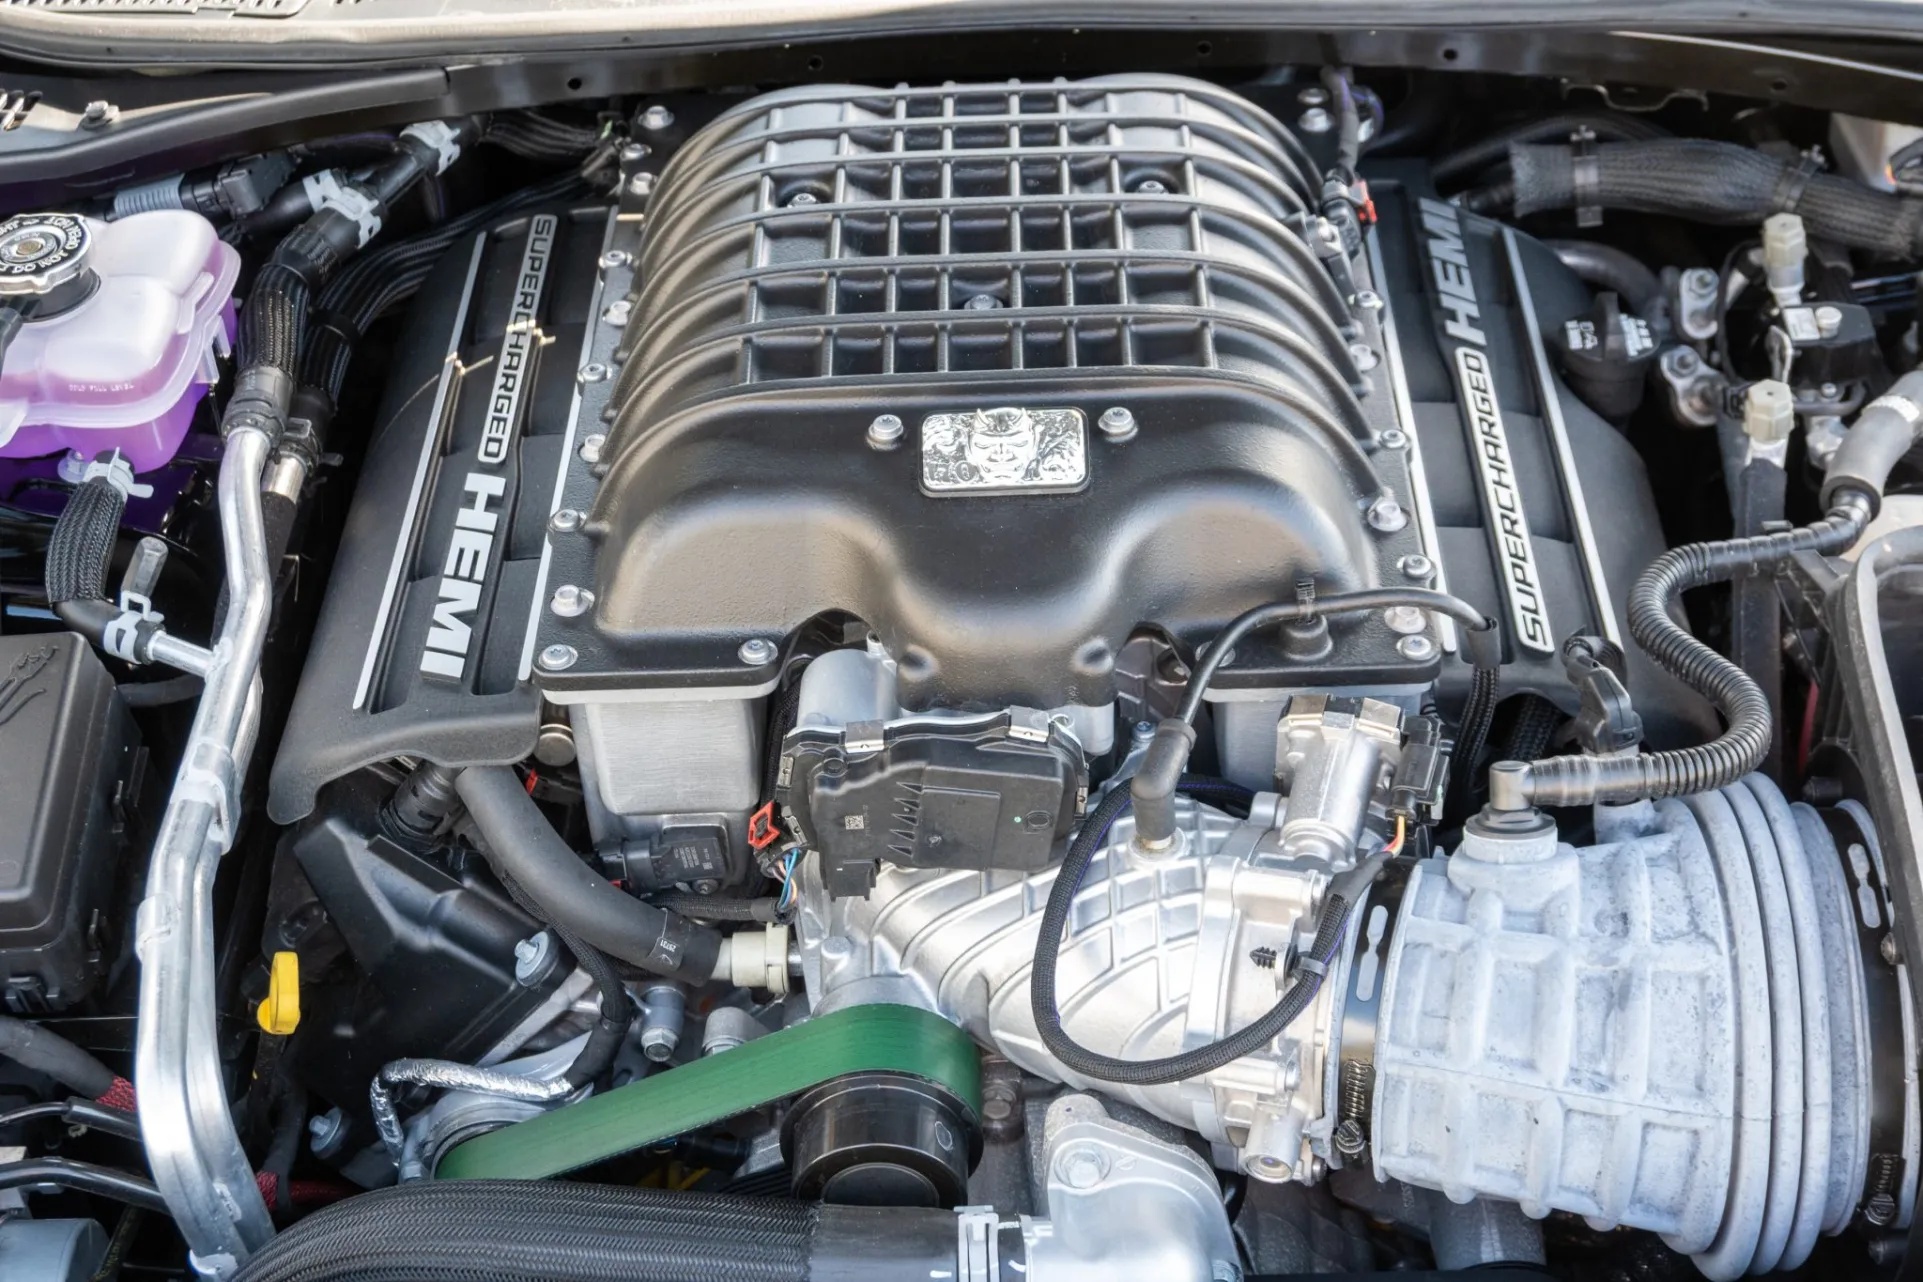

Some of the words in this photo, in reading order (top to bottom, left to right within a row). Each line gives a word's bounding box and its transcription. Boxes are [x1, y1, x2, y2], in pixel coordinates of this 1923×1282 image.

[12, 262, 36, 274] DO
[38, 249, 69, 268] NOT
[484, 218, 552, 459] SUPERCHARGED
[1419, 197, 1487, 346] HEMI
[420, 472, 507, 680] HEMI
[1464, 352, 1547, 647] SUPERCHARGED
